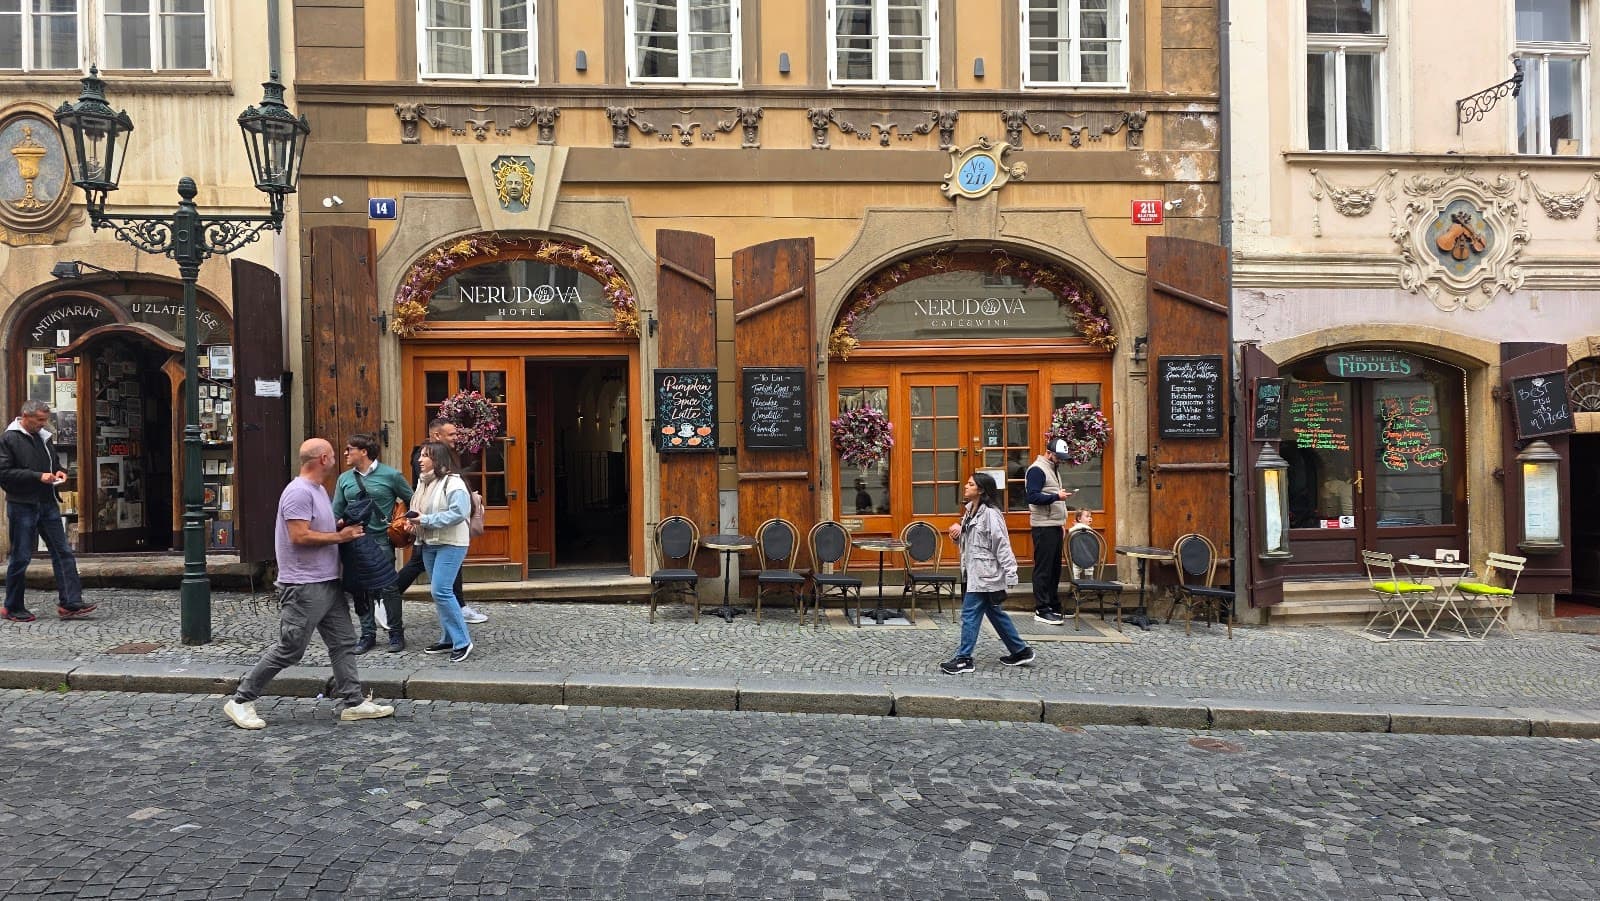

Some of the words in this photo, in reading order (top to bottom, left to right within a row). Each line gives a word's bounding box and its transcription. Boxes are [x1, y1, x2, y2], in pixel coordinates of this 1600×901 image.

[966, 172, 988, 185] 211
[376, 202, 388, 215] 14
[1140, 203, 1156, 214] 211
[459, 284, 583, 304] NERUDOVA
[132, 304, 140, 313] U
[498, 308, 545, 316] HOTEL
[914, 298, 1026, 316] NERUDOVA
[1338, 356, 1411, 377] FIDDLES
[663, 376, 711, 396] Pumpkin
[1518, 381, 1552, 400] BEST
[673, 392, 700, 409] Spice
[672, 407, 701, 419] Latte
